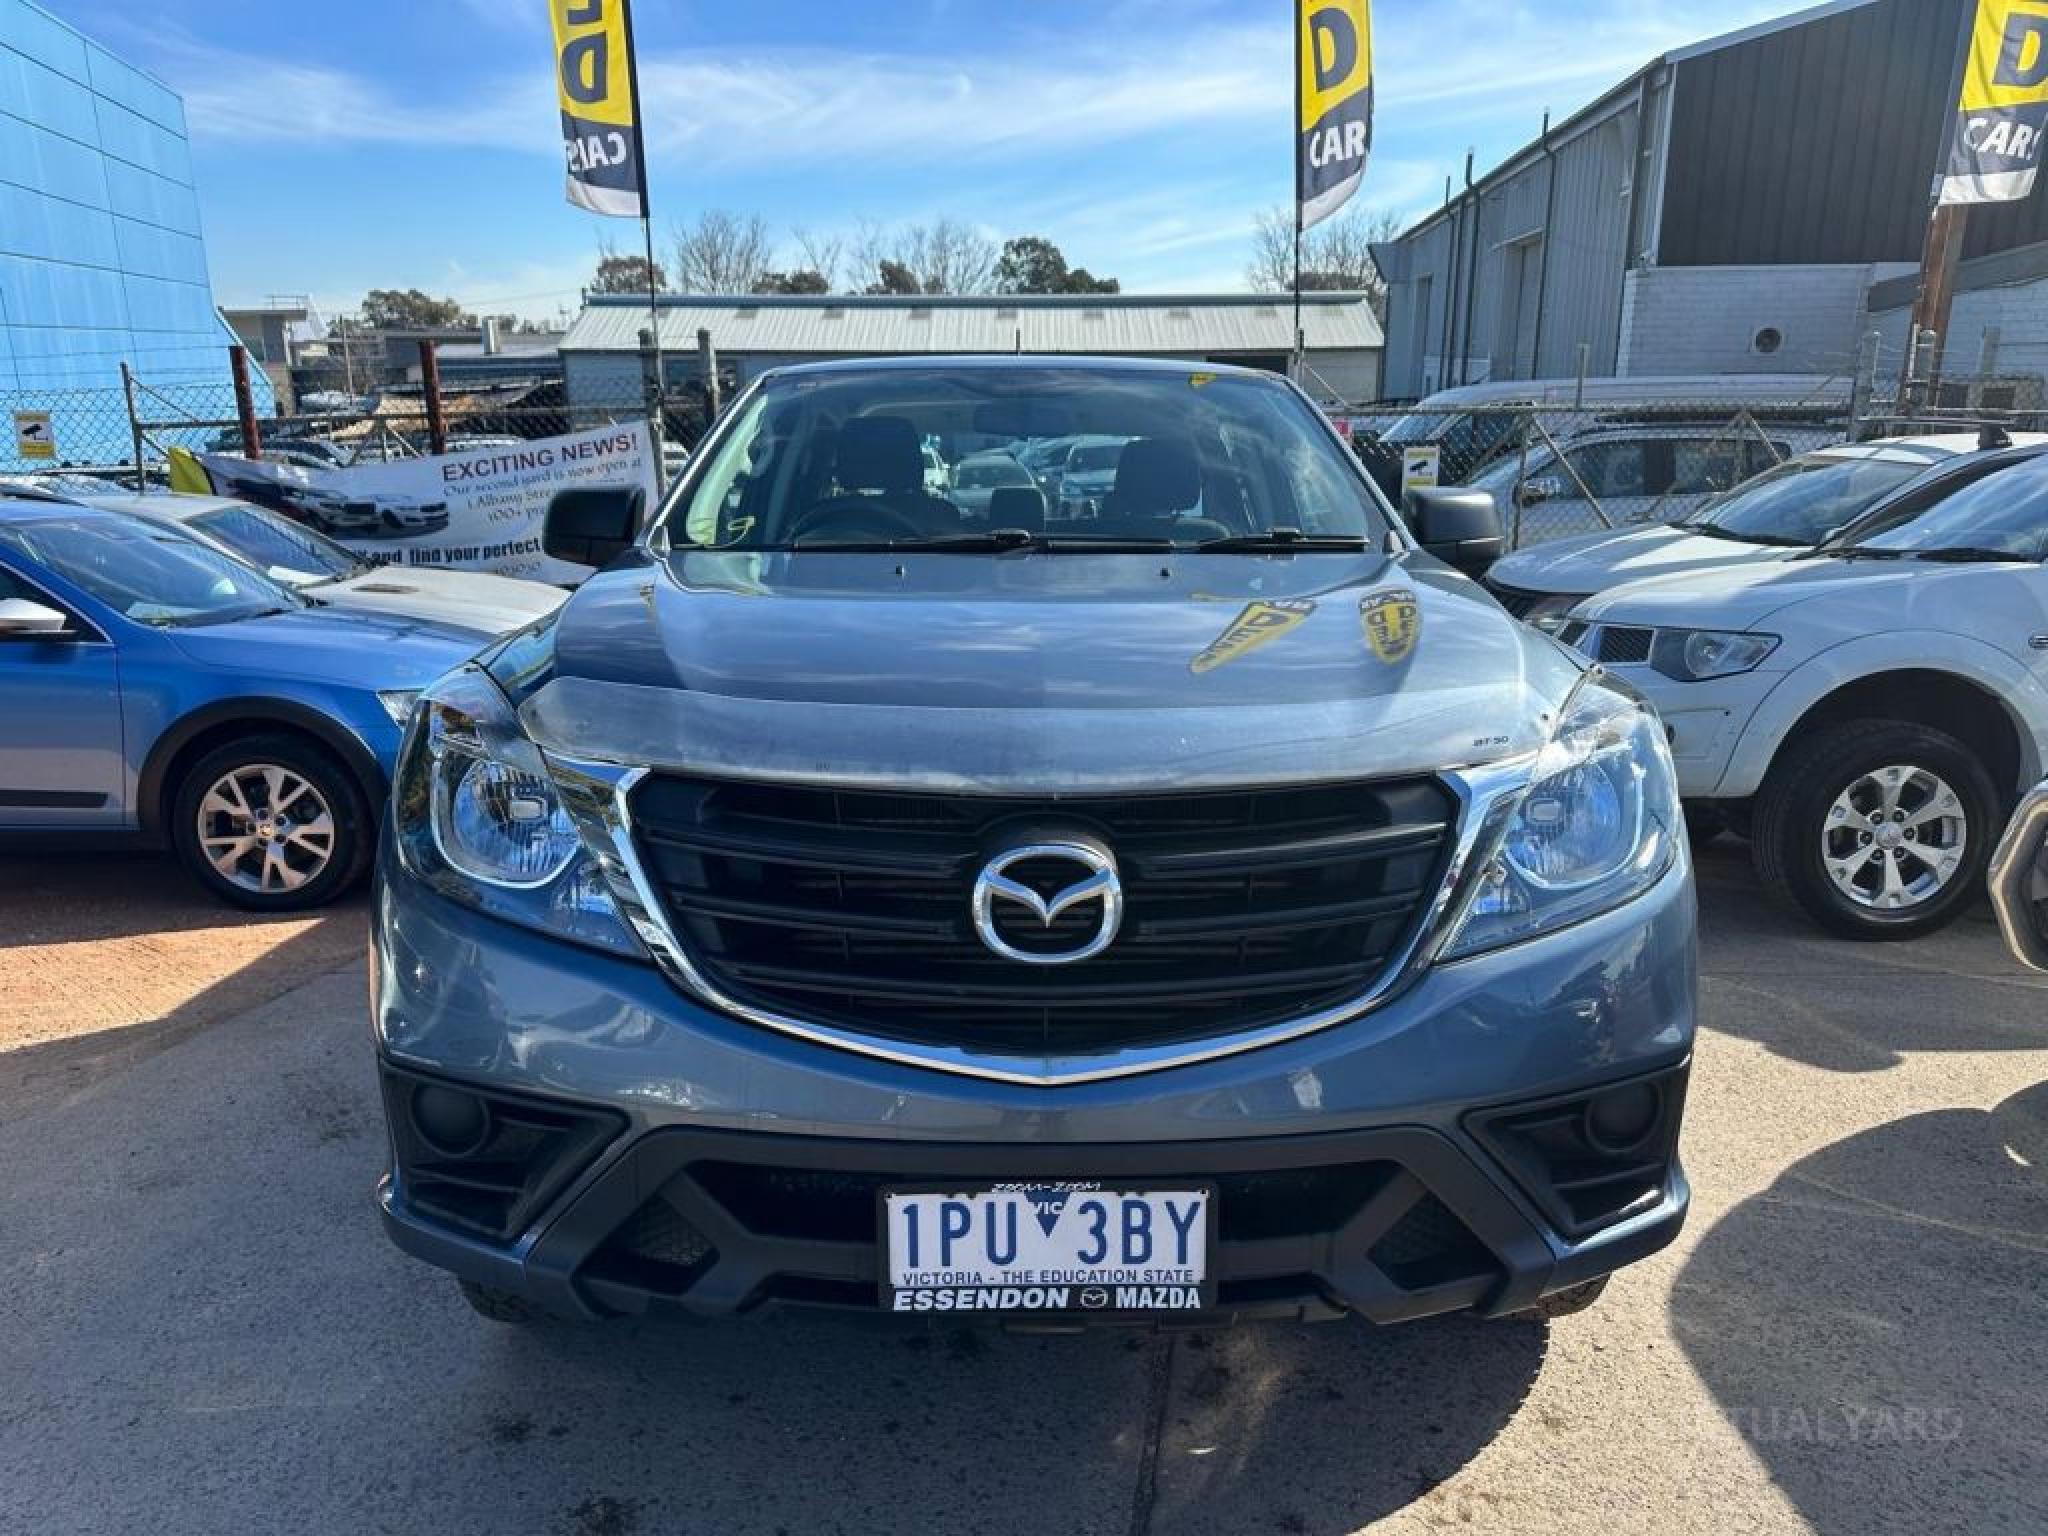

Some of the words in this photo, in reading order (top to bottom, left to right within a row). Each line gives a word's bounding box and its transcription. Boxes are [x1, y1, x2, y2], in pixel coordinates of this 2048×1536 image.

[442, 449, 555, 483] EXCITING
[561, 431, 639, 463] NEWS!
[444, 546, 480, 564] your
[483, 537, 541, 561] perfect
[902, 1201, 1017, 1268] 1PU
[1077, 1200, 1201, 1266] 3BY
[903, 1271, 983, 1286] VICTORIA
[1001, 1270, 1034, 1284] THE
[1039, 1269, 1137, 1284] EDUCATION
[1143, 1268, 1194, 1283] STATE
[893, 1287, 1070, 1310] ESSENDON
[1115, 1286, 1201, 1309] MAZDA
